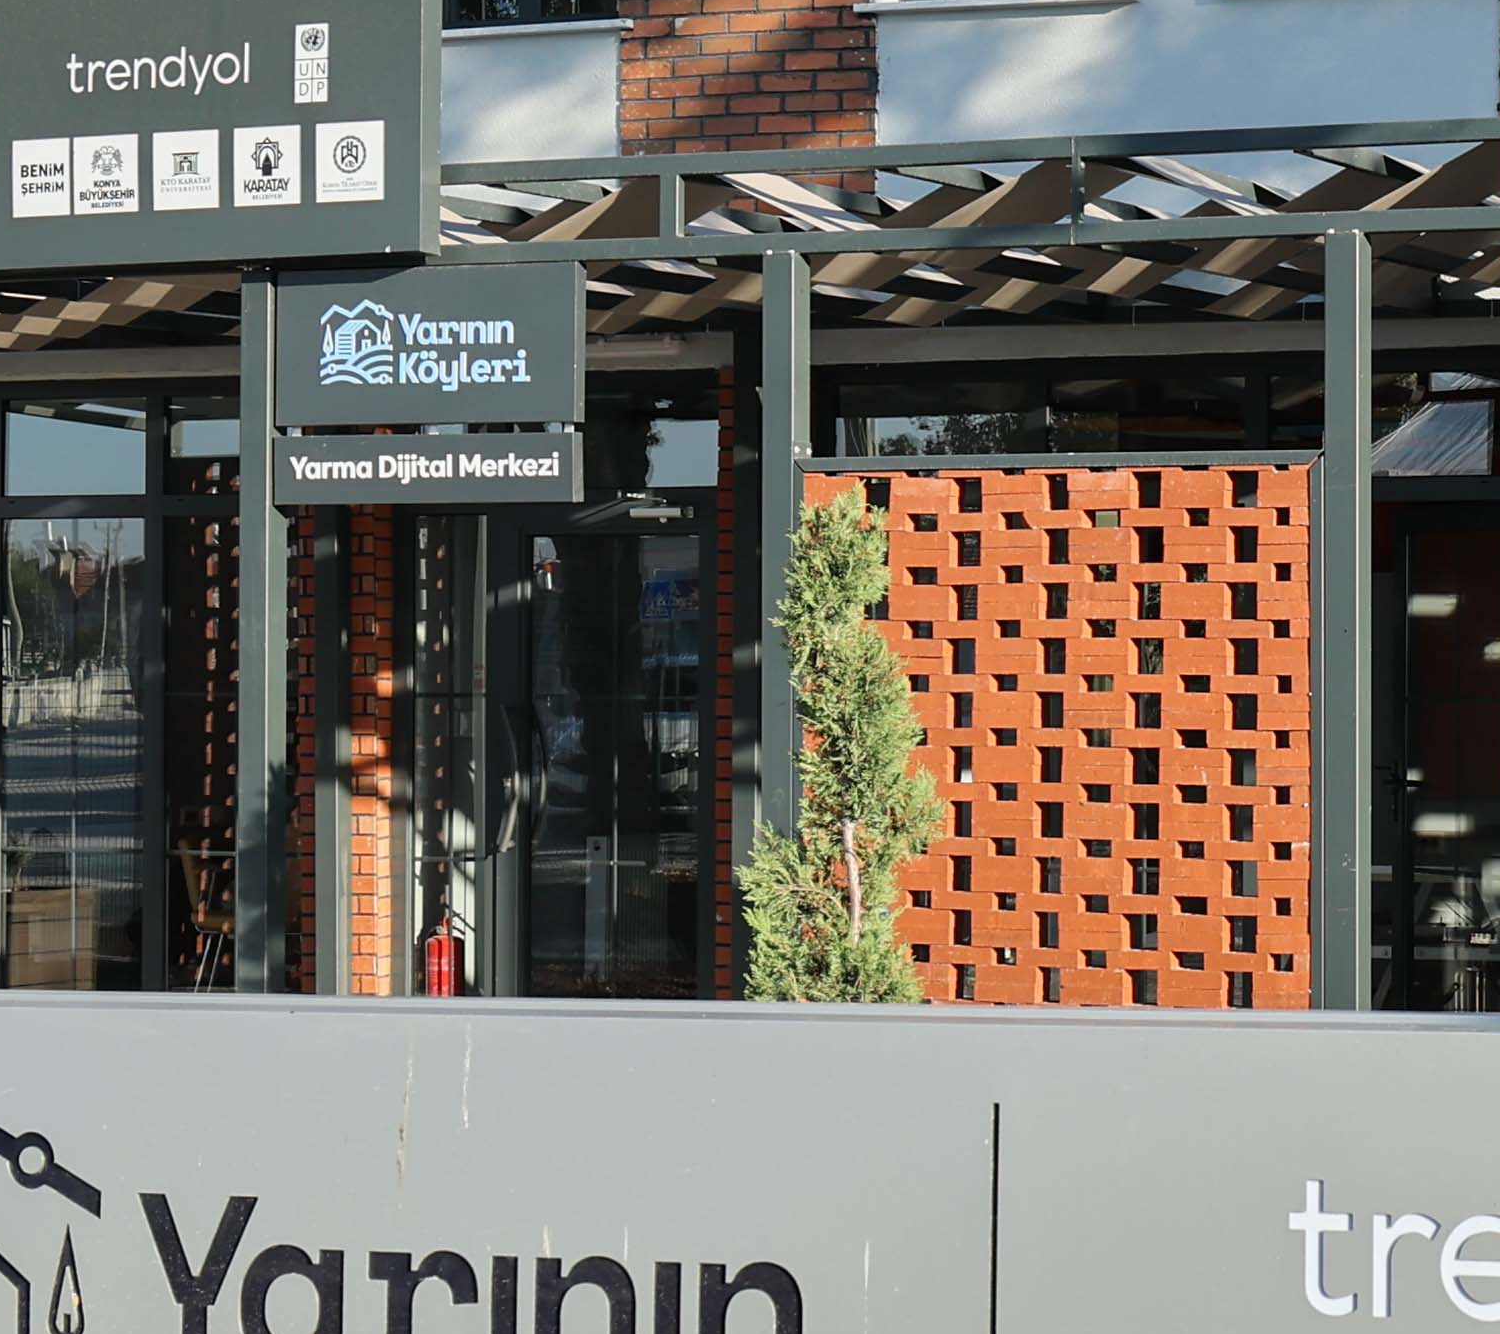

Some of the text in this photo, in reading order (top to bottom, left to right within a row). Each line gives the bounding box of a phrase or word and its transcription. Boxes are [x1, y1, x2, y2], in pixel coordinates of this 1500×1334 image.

[66, 42, 250, 95] trendyol
[80, 188, 135, 201] BÜYÜKŞEHİR
[94, 179, 121, 188] KONYA
[244, 178, 290, 193] KARATAY
[398, 313, 514, 345] Yarının
[399, 349, 531, 391] Köyleri
[289, 451, 560, 485] Yarma Dijital Merkezi
